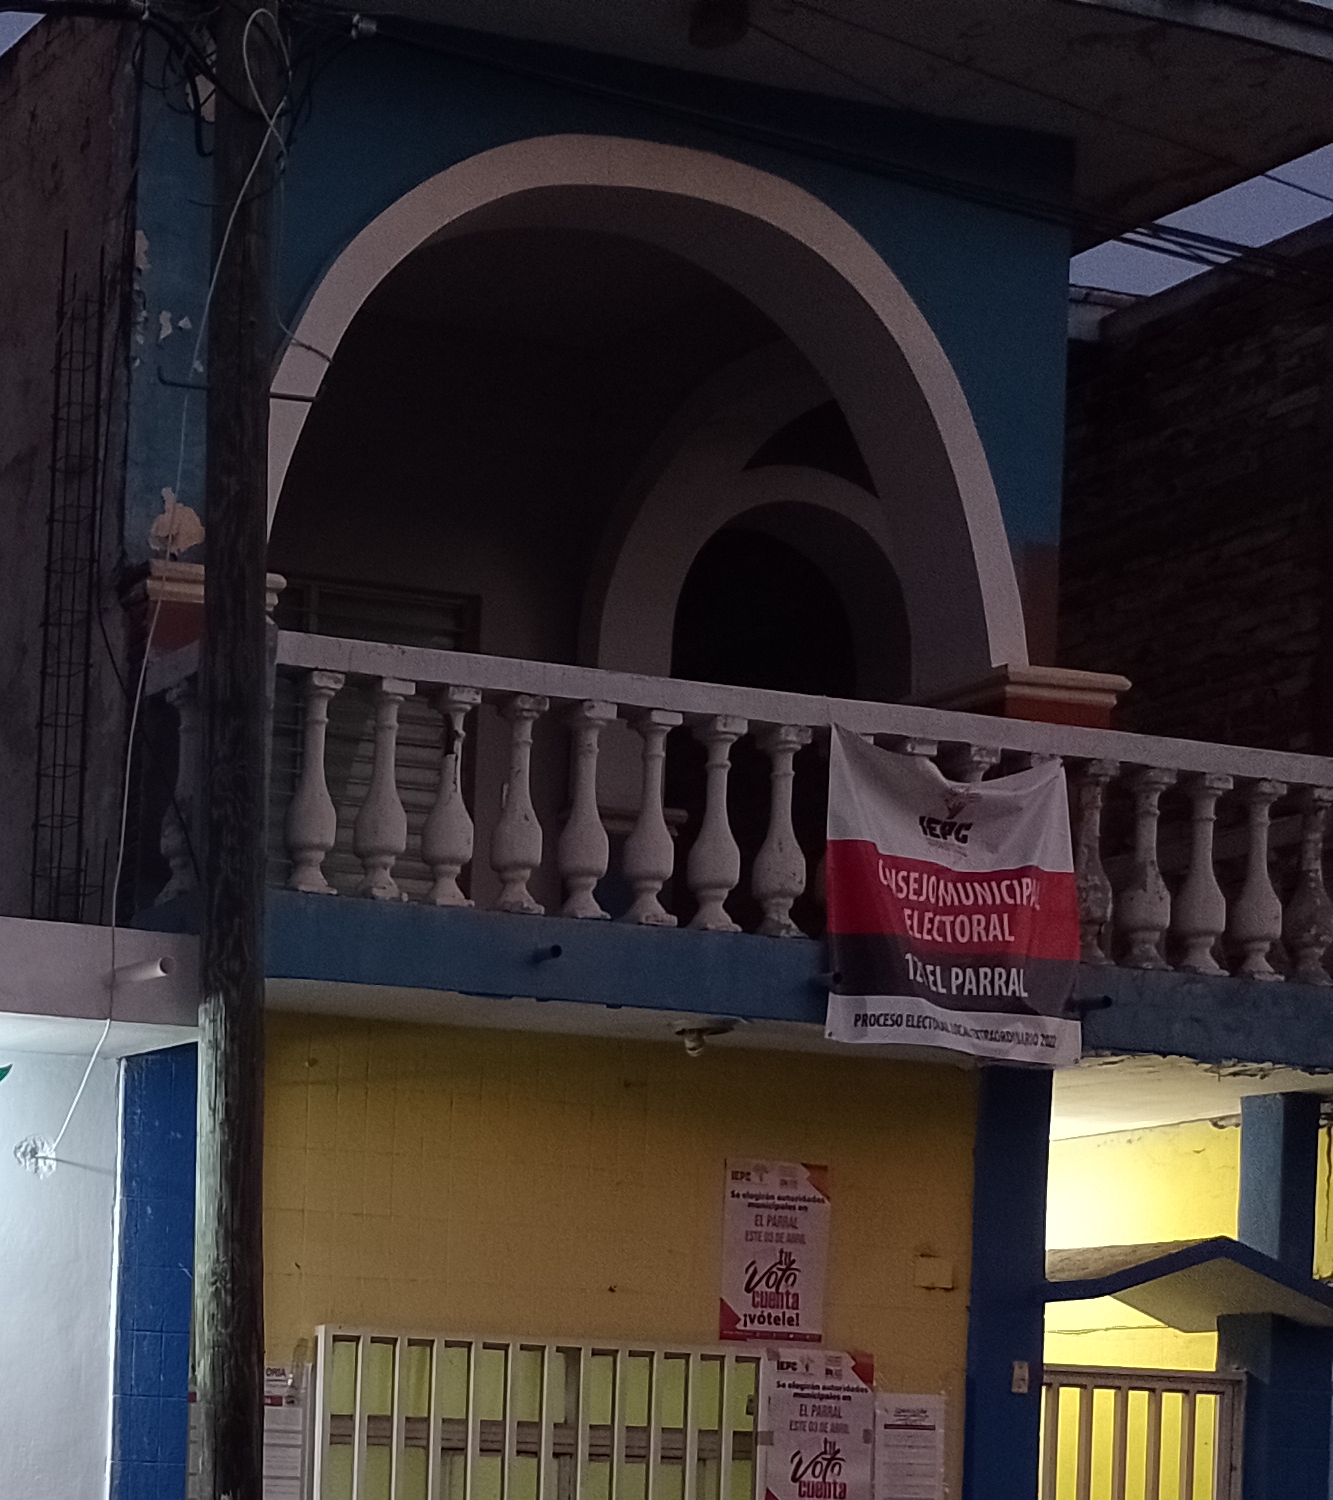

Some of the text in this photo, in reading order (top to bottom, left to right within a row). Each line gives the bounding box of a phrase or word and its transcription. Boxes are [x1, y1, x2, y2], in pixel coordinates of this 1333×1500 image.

[903, 908, 1015, 943] ELECTORAL
[925, 964, 947, 994] EL
[950, 967, 1028, 998] PARRAL
[854, 1013, 903, 1028] PROCESO
[754, 1214, 799, 1229] EL PARRAL
[752, 1290, 800, 1310] cuenta
[743, 1310, 800, 1328] ¡vótele!
[799, 1403, 843, 1419] EL PARRAL
[798, 1480, 847, 1500] cuenta
